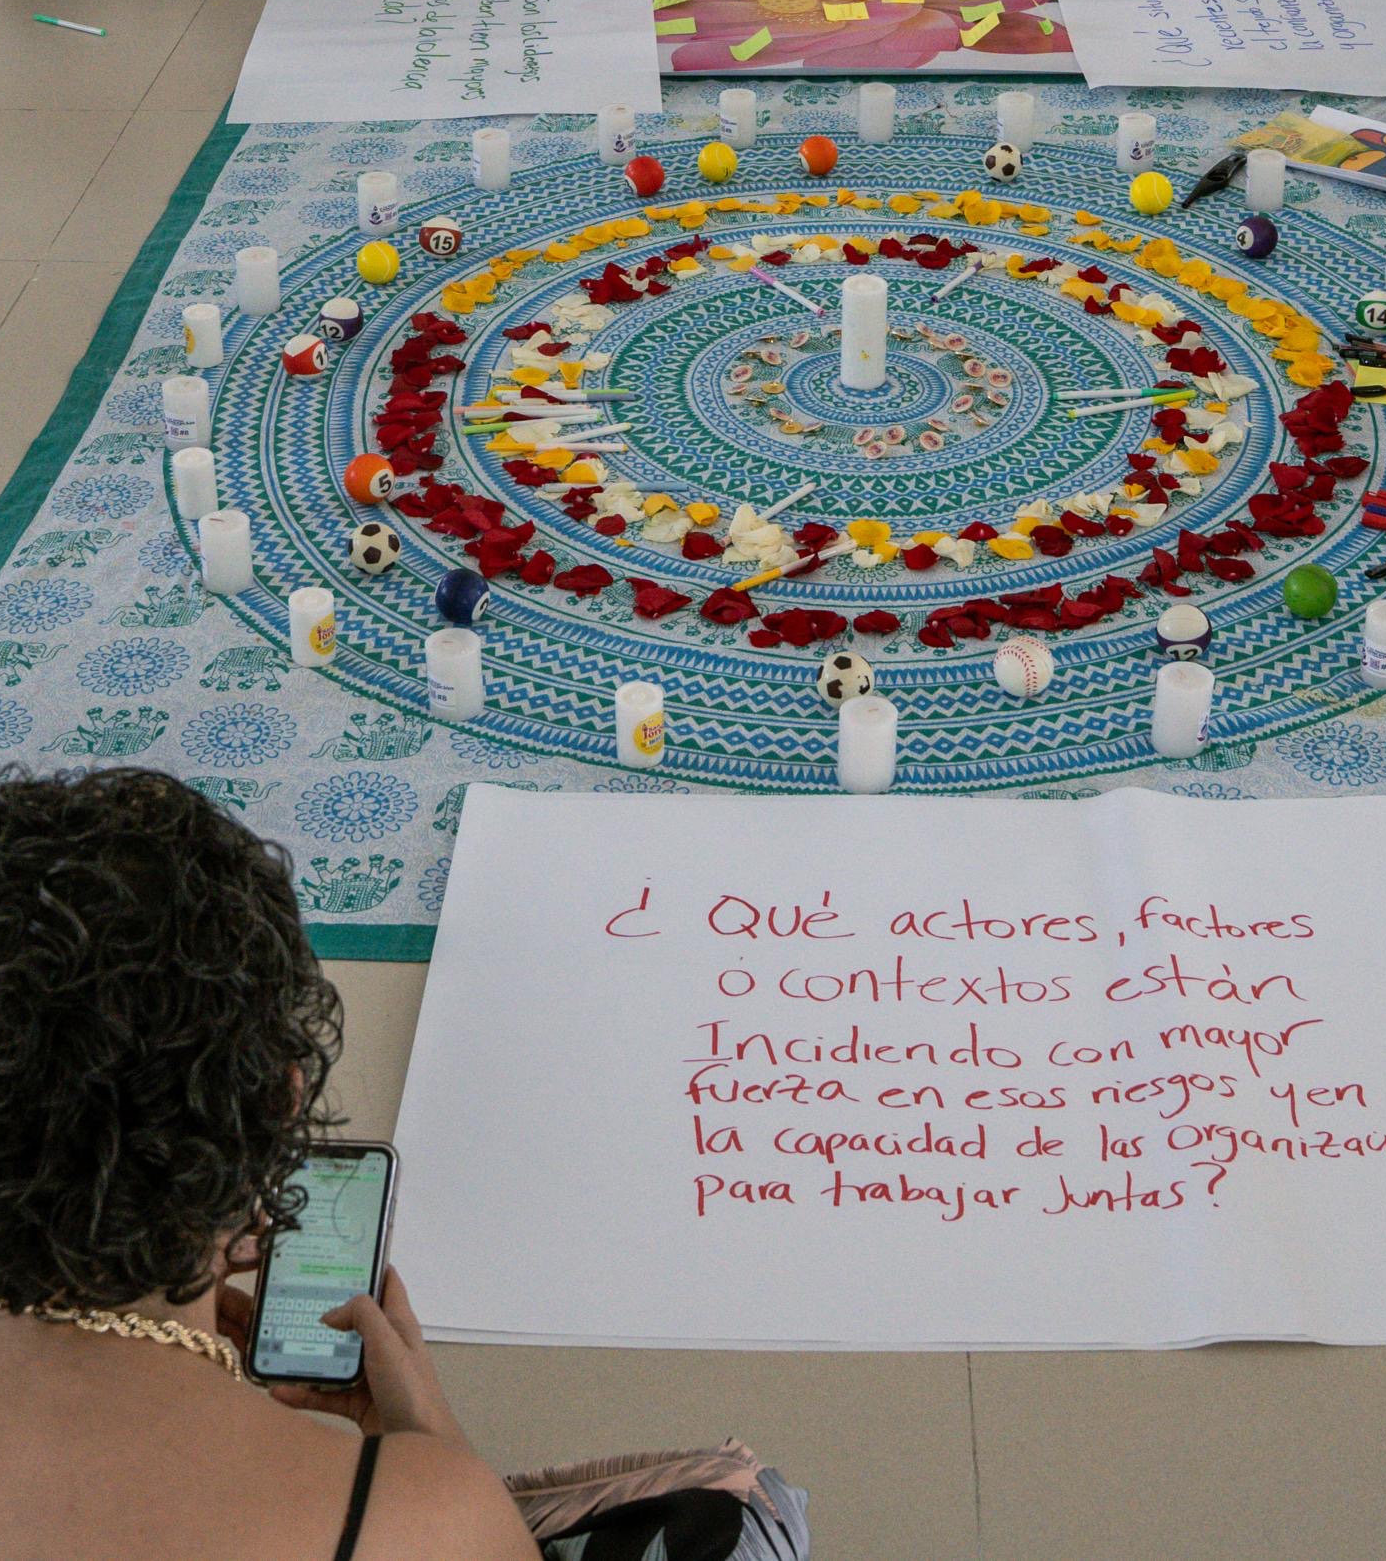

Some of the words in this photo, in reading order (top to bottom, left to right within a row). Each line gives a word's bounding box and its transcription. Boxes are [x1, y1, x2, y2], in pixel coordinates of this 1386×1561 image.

[432, 234, 453, 251] 15
[321, 324, 342, 339] 12
[378, 473, 392, 494] 5
[1169, 648, 1199, 661] 12
[889, 899, 1126, 948] actores,
[1135, 896, 1316, 942] factores
[777, 955, 1075, 1005] contextos
[1104, 952, 1307, 1003] están
[683, 1018, 1025, 1070] Incidiendo
[1047, 1038, 1137, 1068] con
[1158, 1018, 1325, 1080] mayor
[685, 1062, 863, 1106] fuerza
[875, 1085, 947, 1110] en
[963, 1086, 1069, 1112] esos
[1089, 1070, 1239, 1122] riesgos
[691, 1115, 745, 1158] la
[772, 1123, 989, 1165] capacidad
[1015, 1123, 1065, 1160] de
[1097, 1123, 1147, 1162] las
[693, 1173, 797, 1220] para
[820, 1170, 1021, 1223] trabajar
